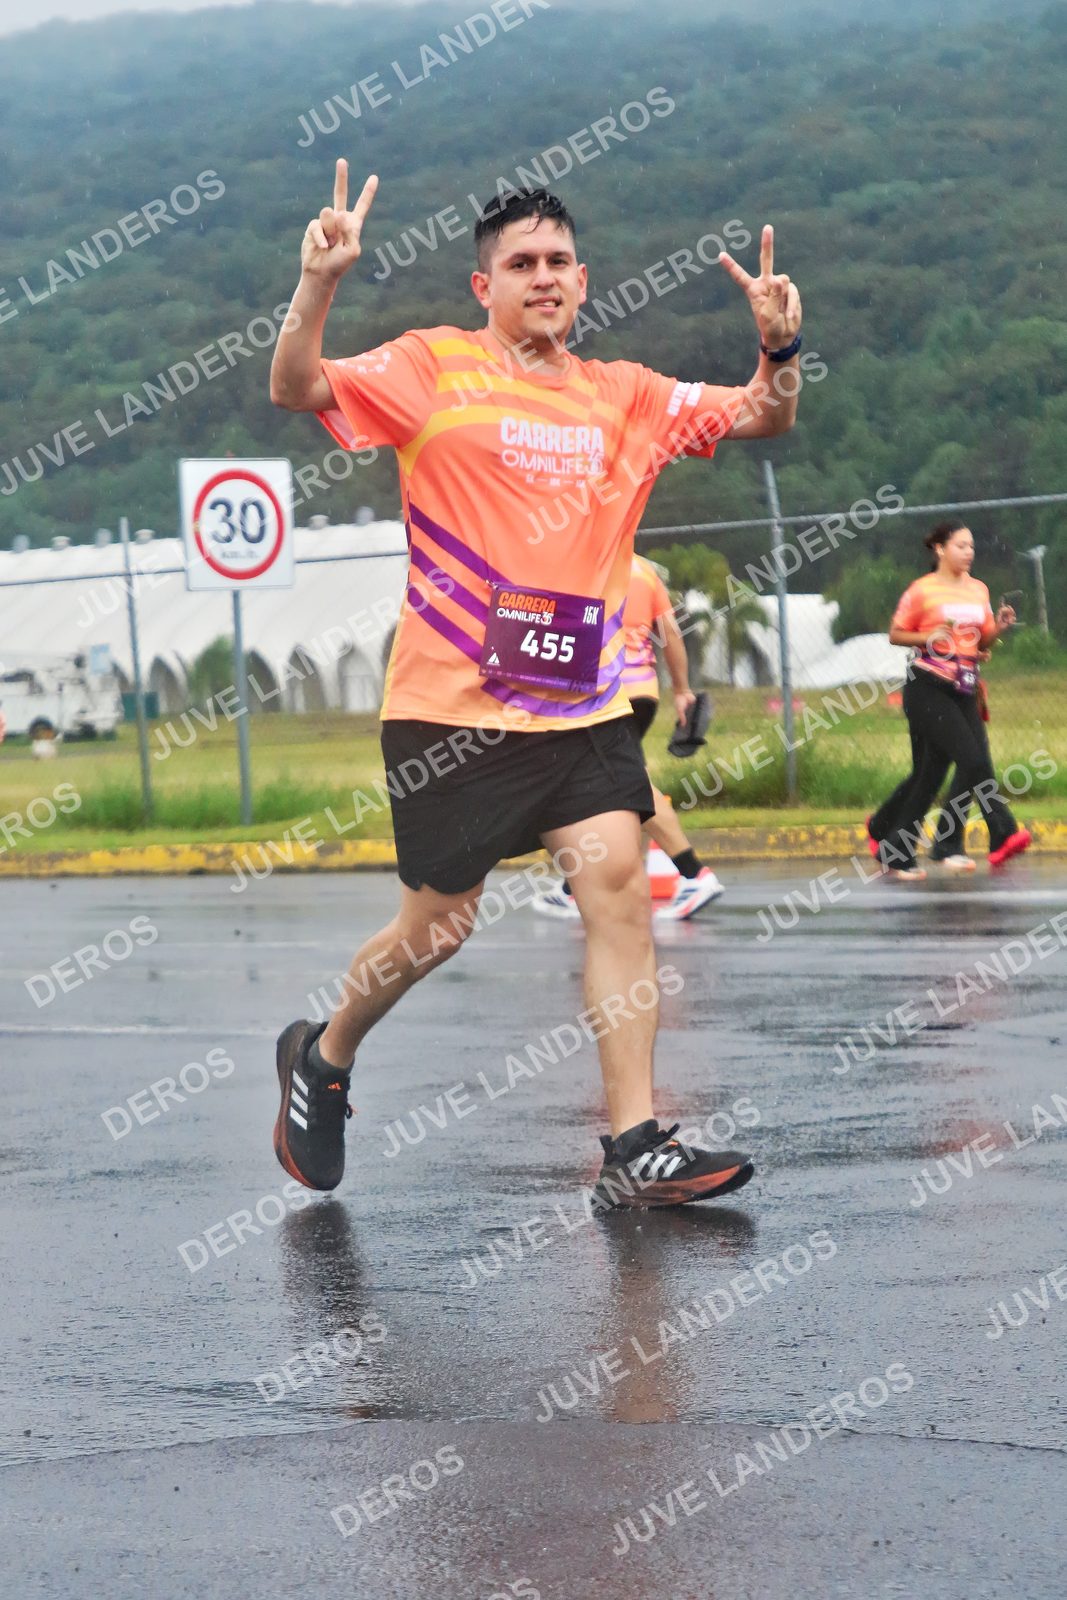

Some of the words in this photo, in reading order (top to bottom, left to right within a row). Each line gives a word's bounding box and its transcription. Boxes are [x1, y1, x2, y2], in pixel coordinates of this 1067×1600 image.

[500, 416, 605, 456] CARRERA
[501, 448, 586, 475] OMNILIFE
[208, 497, 265, 544] 30
[496, 607, 542, 624] OMNILIFE
[498, 592, 557, 614] CARRERA
[582, 605, 600, 625] 15K
[520, 629, 576, 663] 455
